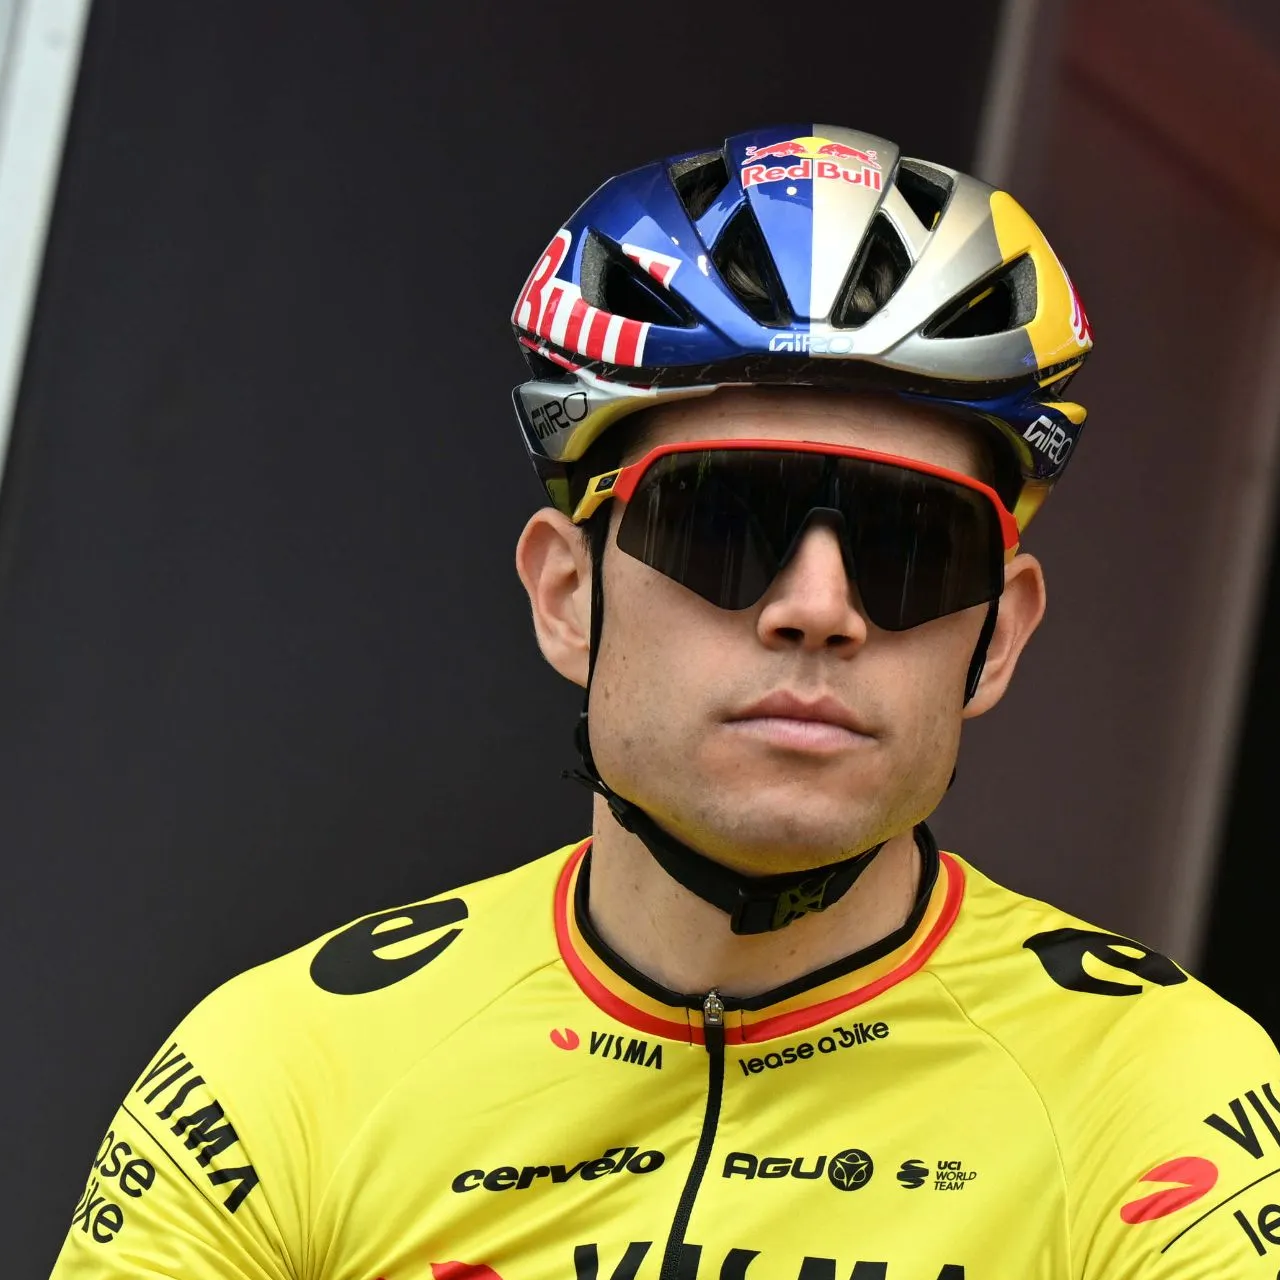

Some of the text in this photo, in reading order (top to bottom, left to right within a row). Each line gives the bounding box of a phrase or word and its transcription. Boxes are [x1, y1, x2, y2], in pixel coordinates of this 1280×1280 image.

[741, 159, 883, 193] Red Bull
[589, 1031, 663, 1070] VISMA
[739, 1042, 814, 1076] lease
[135, 1042, 260, 1214] VISMA
[451, 1146, 665, 1193] cervélo
[722, 1151, 827, 1181] AGU
[935, 1171, 977, 1181] WORLD
[936, 1160, 962, 1171] UCI
[934, 1181, 964, 1191] TEAM
